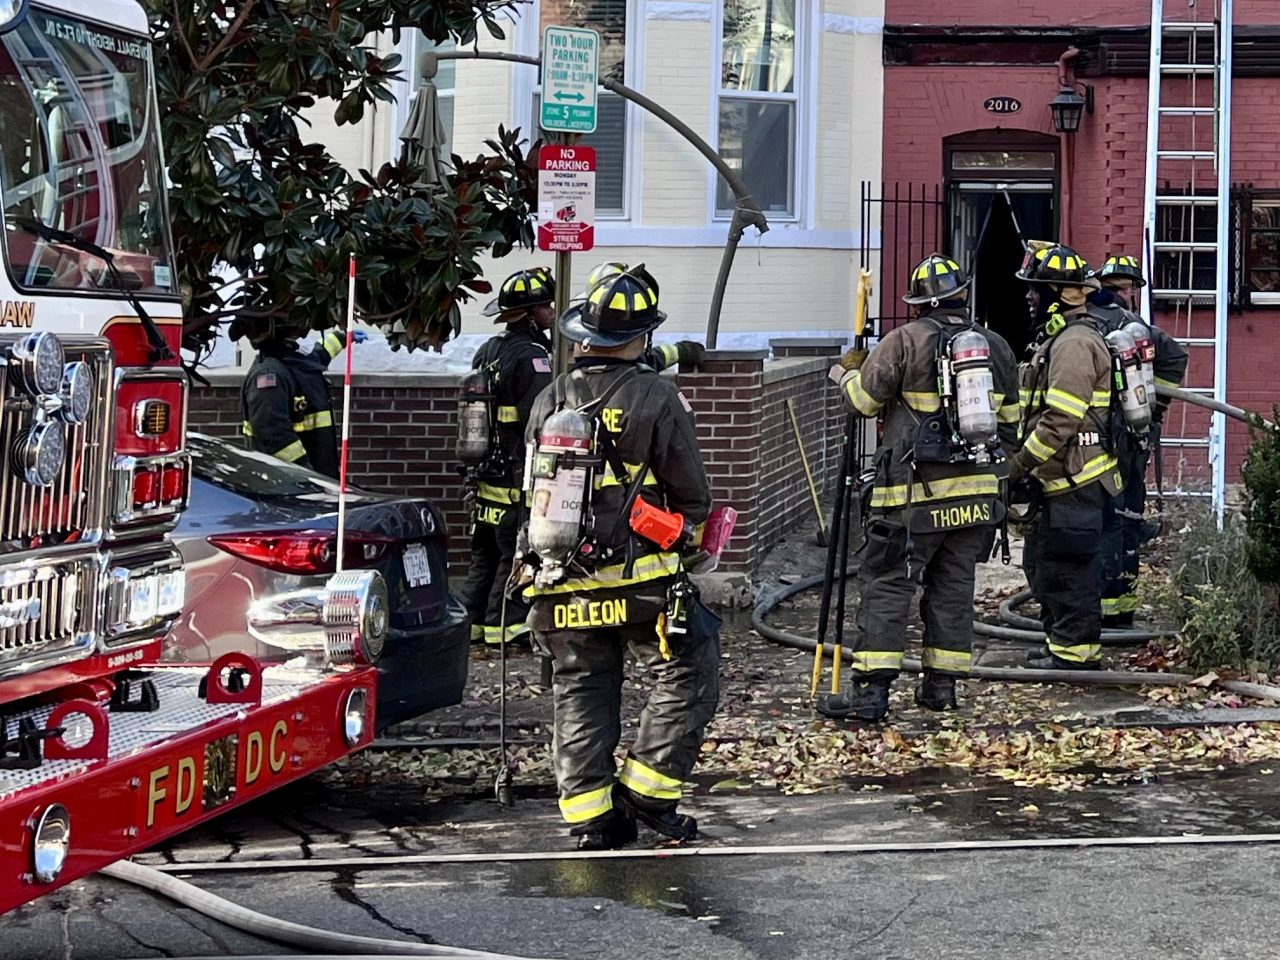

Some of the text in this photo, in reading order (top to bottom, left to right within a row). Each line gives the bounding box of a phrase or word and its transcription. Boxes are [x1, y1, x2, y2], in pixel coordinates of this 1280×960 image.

[549, 34, 594, 50] TWO HOUR
[552, 48, 589, 64] PARKING
[563, 106, 570, 120] 5
[987, 100, 1019, 111] 2016
[560, 148, 576, 160] NO
[546, 159, 590, 171] PARKING
[553, 234, 580, 243] STREET
[0, 300, 35, 328] AW
[930, 502, 990, 528] THOMAS
[554, 598, 628, 629] DELEON
[146, 719, 288, 828] FD DC
